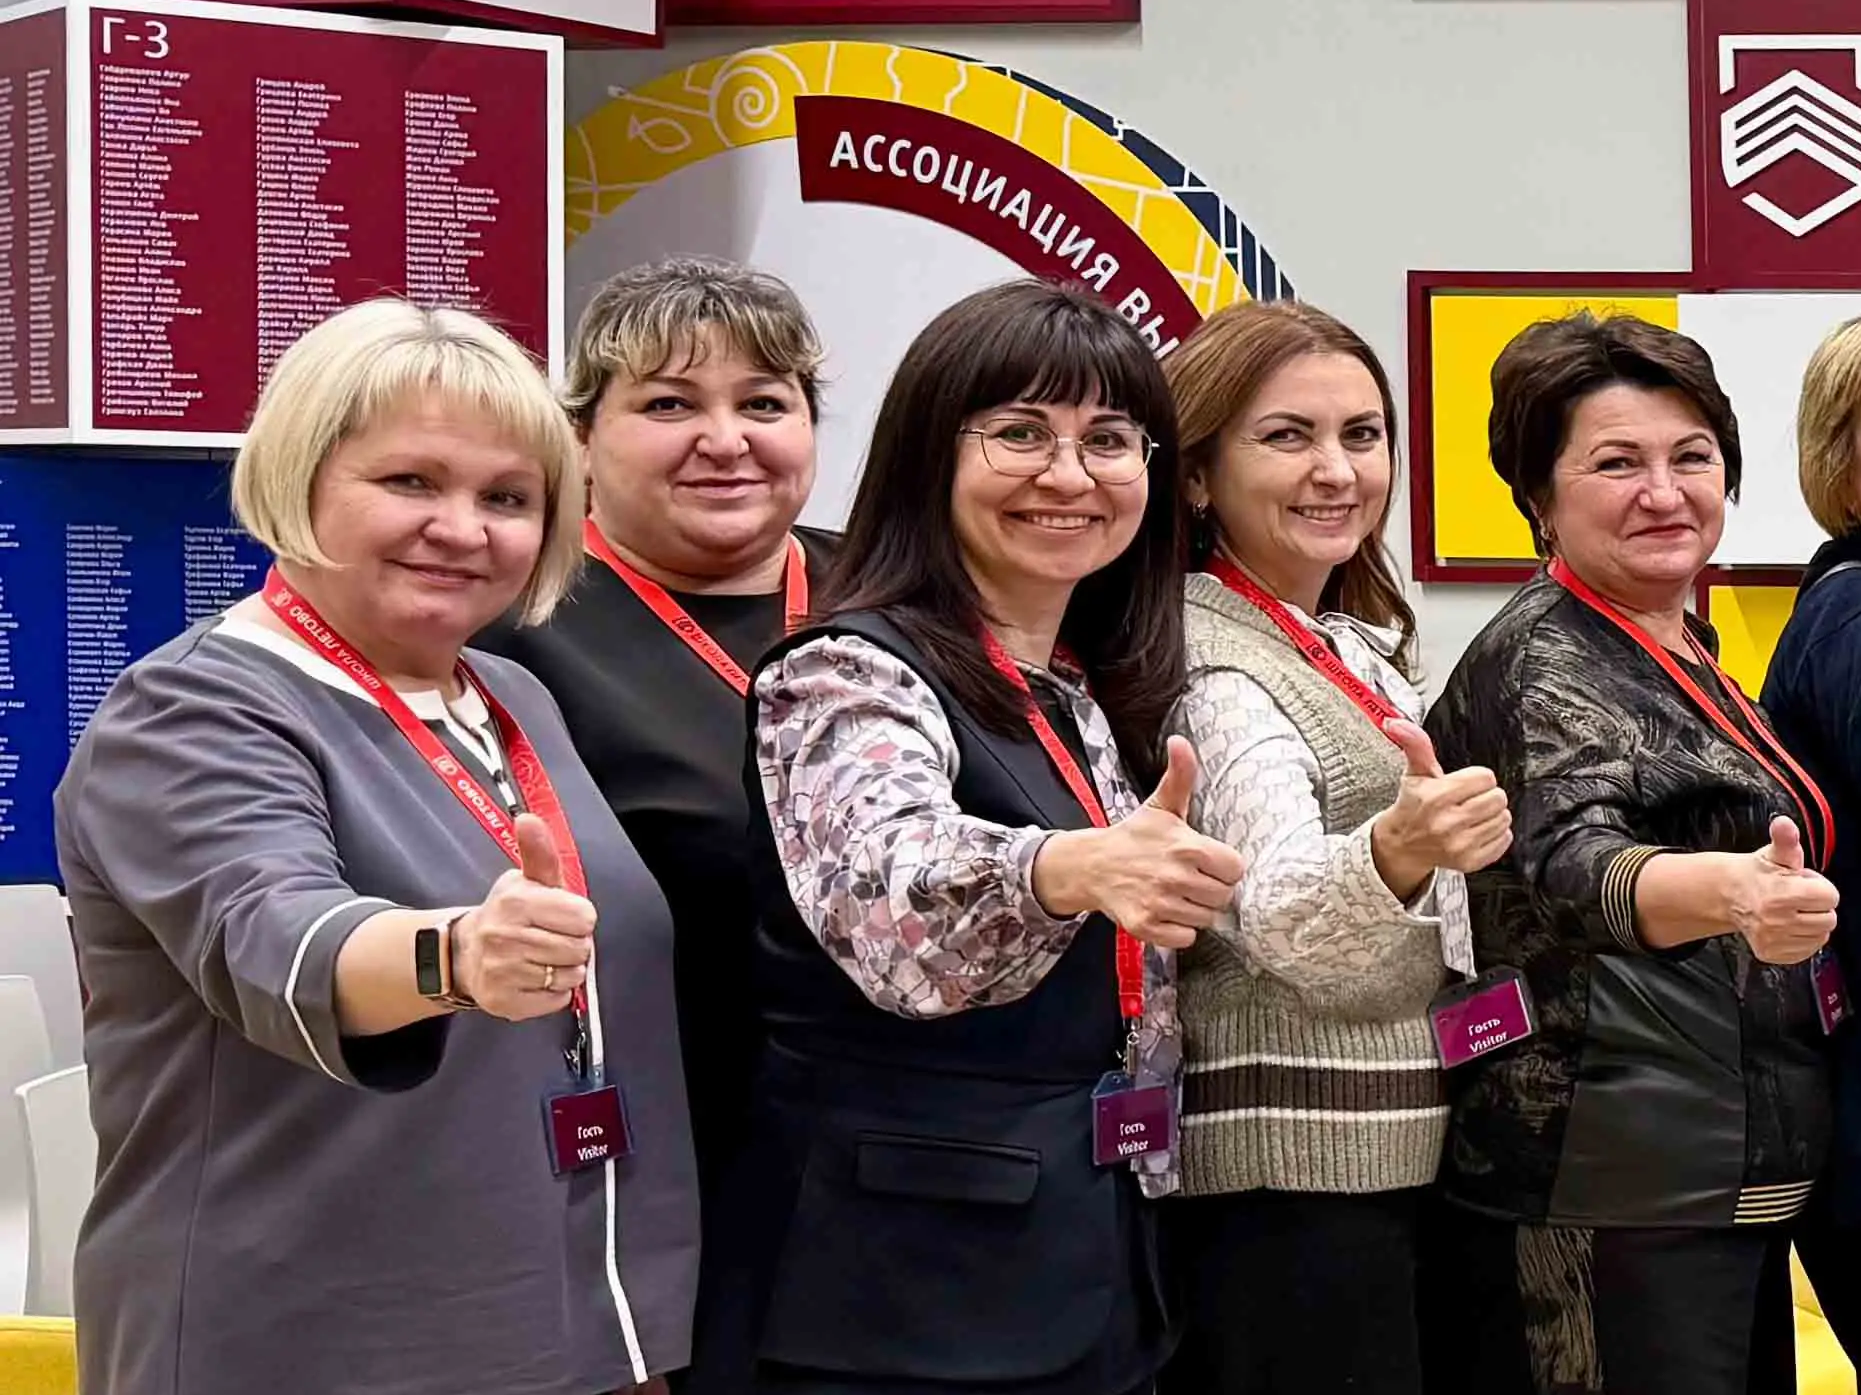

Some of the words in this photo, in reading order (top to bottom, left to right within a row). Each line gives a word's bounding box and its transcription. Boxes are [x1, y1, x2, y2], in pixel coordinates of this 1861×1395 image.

[830, 129, 1121, 292] АССОЦИАЦИЯ
[1115, 286, 1183, 361] ВЫ
[289, 606, 341, 650] ЛЕТОВО
[337, 649, 382, 691] ШКОЛА
[1468, 1018, 1502, 1037] Гость
[1469, 1031, 1509, 1053] Visitor
[578, 1125, 604, 1139] Гость
[1119, 1122, 1146, 1136] Гость
[577, 1142, 609, 1161] Visitor
[1117, 1140, 1149, 1156] Visitor
